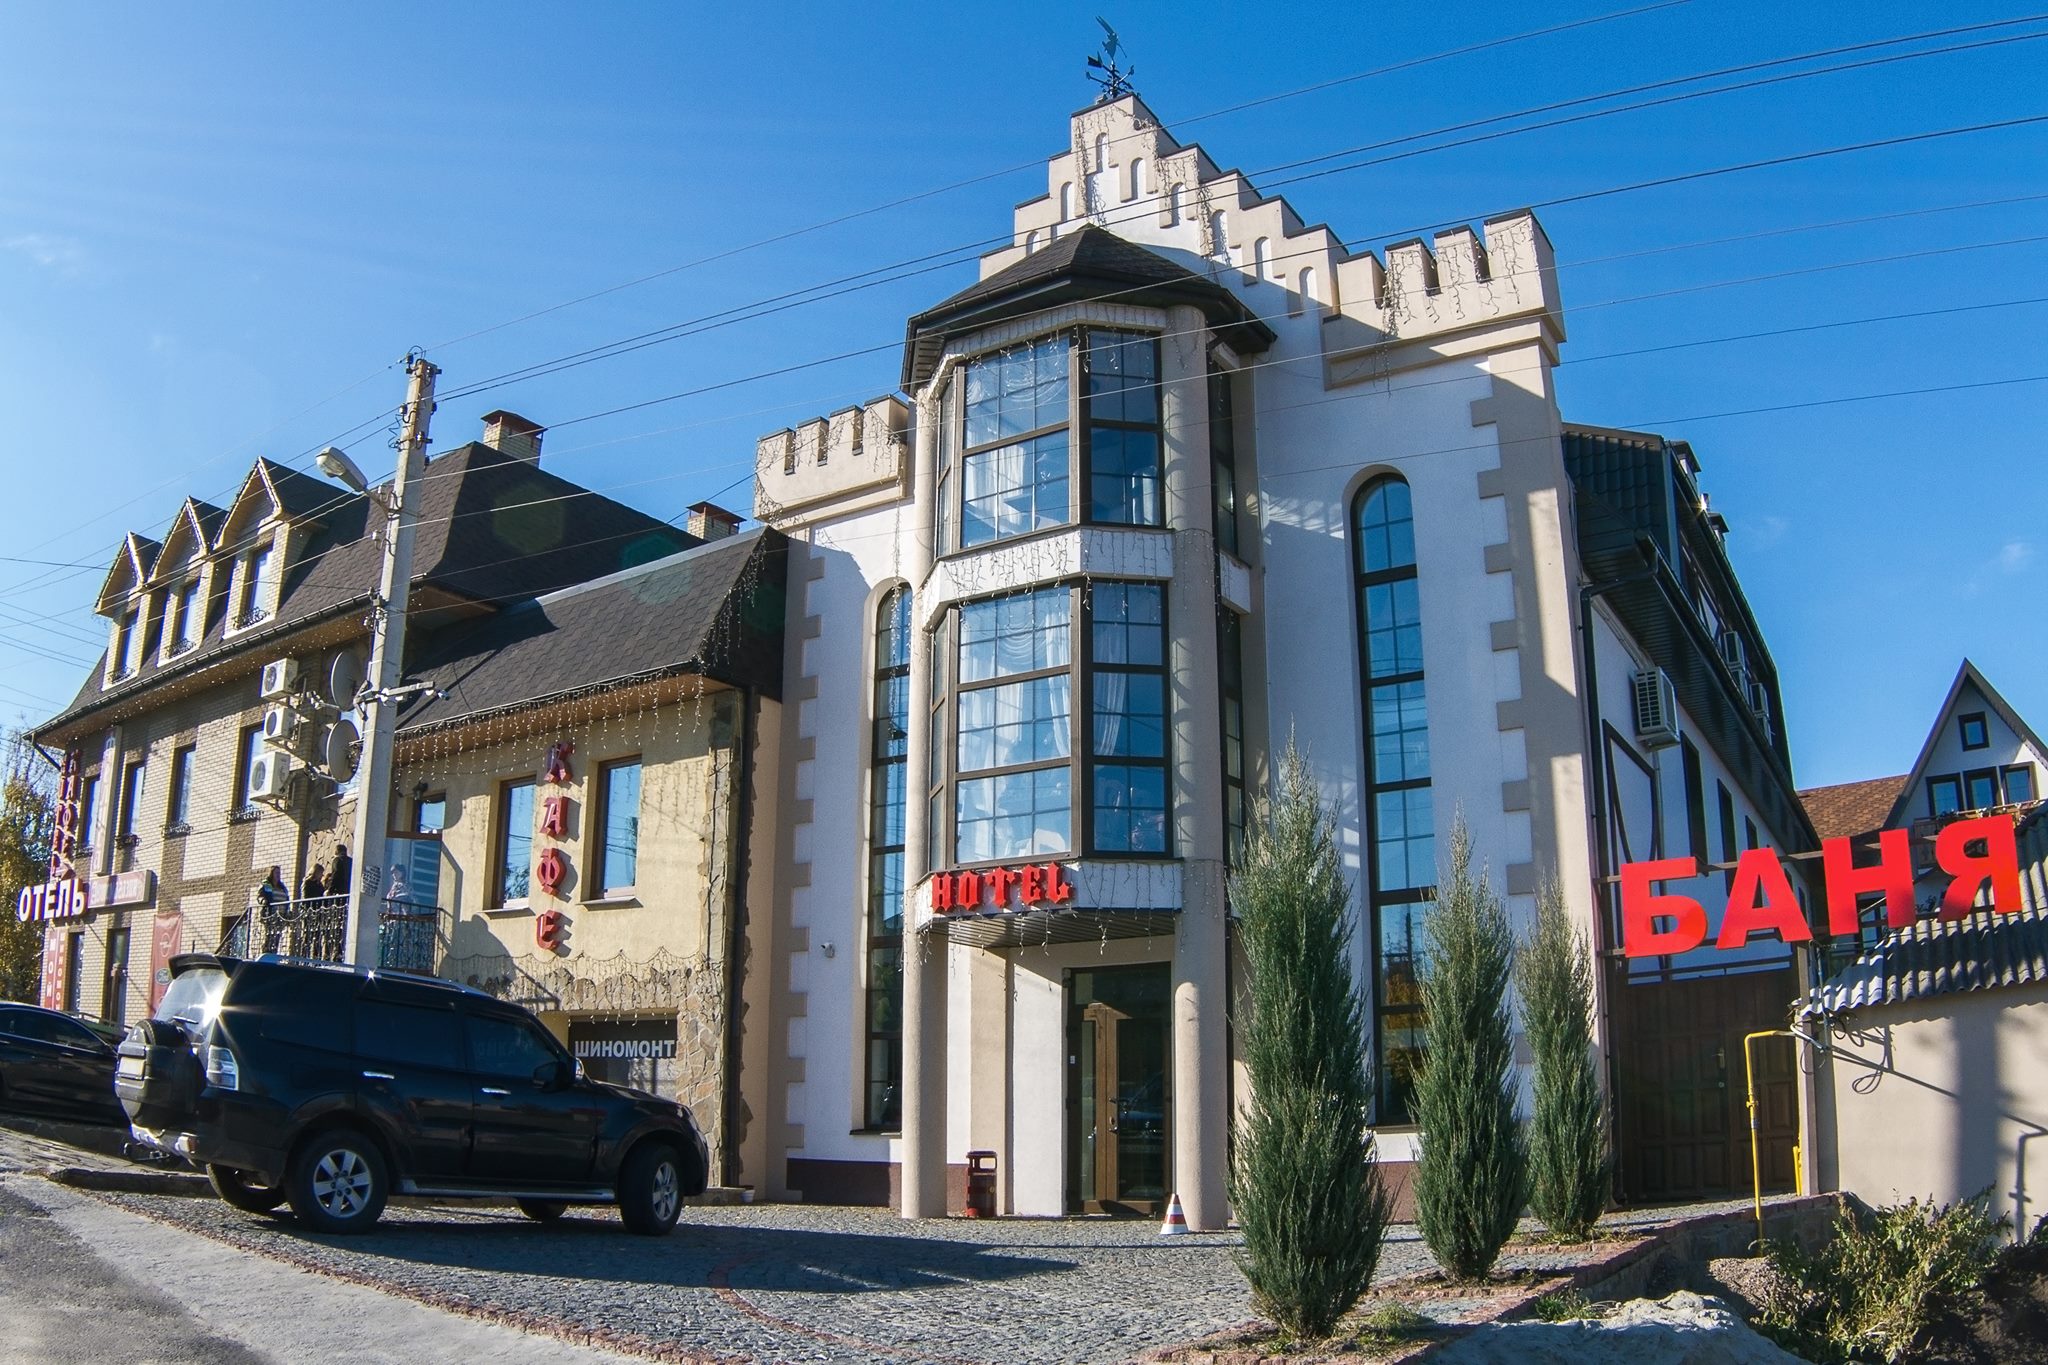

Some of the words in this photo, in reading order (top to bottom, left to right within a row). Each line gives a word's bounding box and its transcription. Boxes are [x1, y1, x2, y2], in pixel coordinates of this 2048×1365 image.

[536, 741, 574, 951] КАФЕ
[18, 879, 86, 922] ОТЕЛЬ
[930, 861, 1074, 912] HOTEL
[1621, 814, 2022, 958] БАНЯ
[575, 1040, 677, 1058] ШИНОМОНТ
